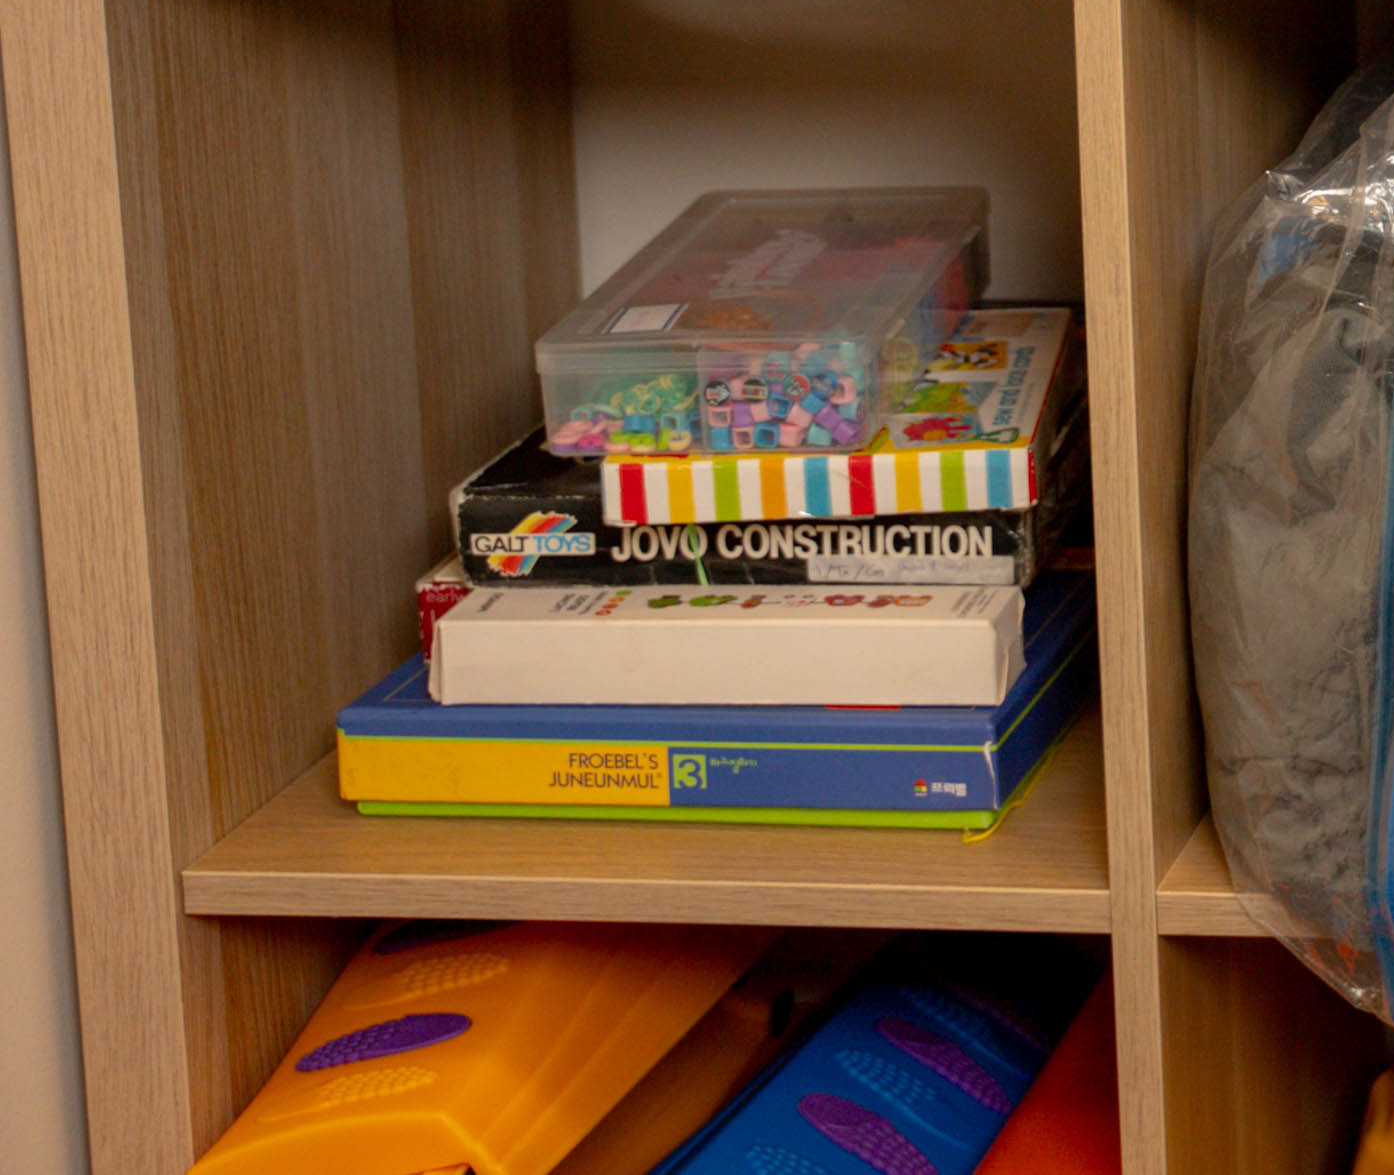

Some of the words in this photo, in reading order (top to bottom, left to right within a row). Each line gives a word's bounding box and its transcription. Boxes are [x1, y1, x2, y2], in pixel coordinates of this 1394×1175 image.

[474, 534, 526, 554] GALT
[534, 534, 592, 554] TOYS
[610, 524, 709, 562] JOVO
[716, 523, 995, 560] CONSTRUCTION
[676, 757, 704, 789] 3
